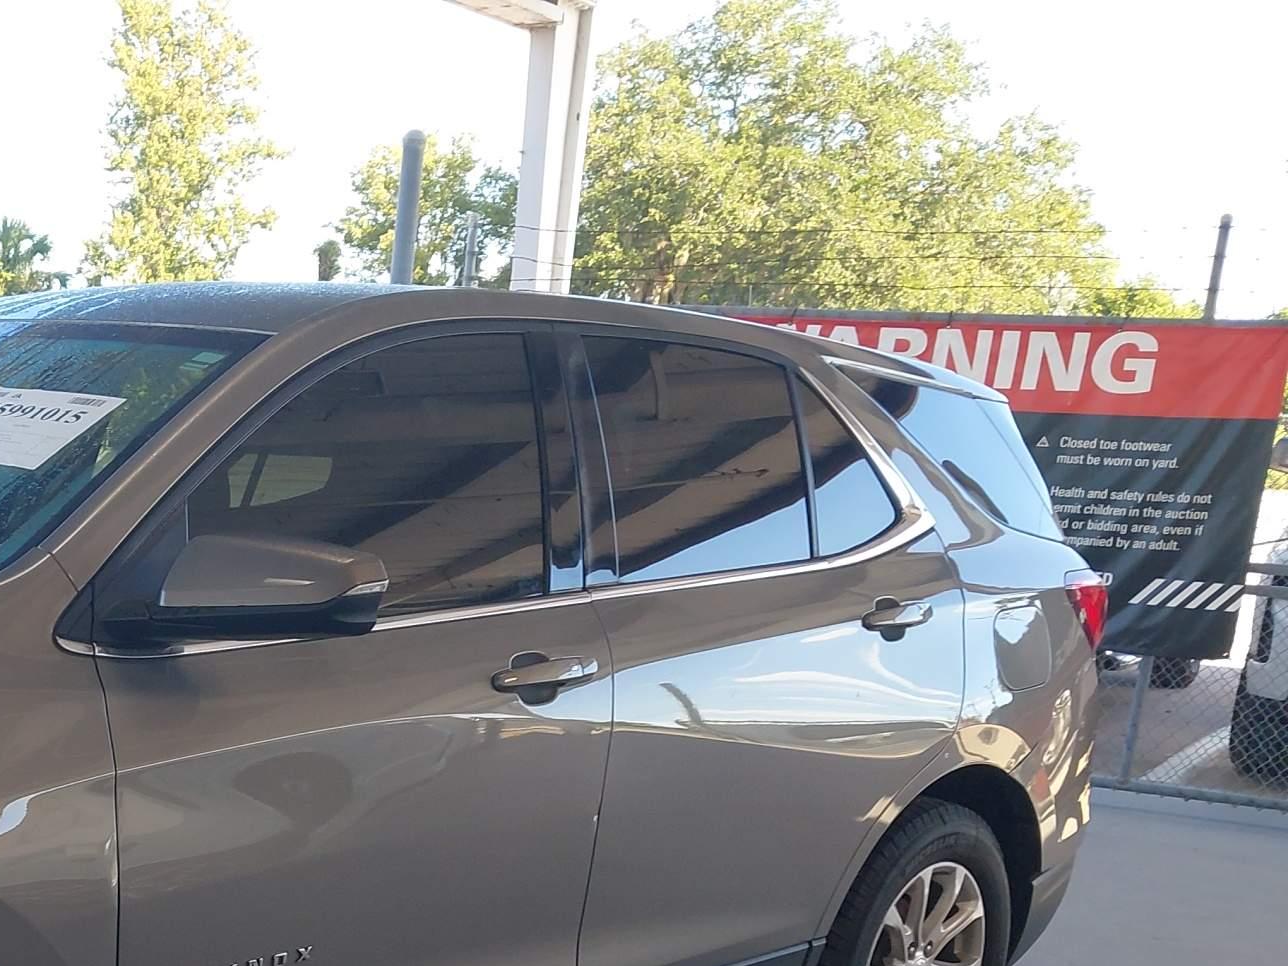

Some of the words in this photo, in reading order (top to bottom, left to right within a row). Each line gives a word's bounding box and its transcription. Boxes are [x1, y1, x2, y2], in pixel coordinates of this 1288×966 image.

[776, 323, 1159, 395] RNING
[1060, 436, 1097, 449] Closed
[1099, 439, 1117, 449] toe
[1120, 439, 1172, 452] footwear
[1056, 454, 1084, 464] must
[1087, 454, 1100, 465] be
[1103, 457, 1132, 466] worn
[1135, 458, 1149, 467] on
[1152, 457, 1179, 470] yard.
[1050, 486, 1084, 498] Health
[1087, 487, 1108, 499] and
[1110, 488, 1144, 502] safety
[1146, 491, 1174, 502] rules
[1177, 493, 1190, 503] do
[1193, 494, 1212, 504] not
[1054, 504, 1081, 513] ermit
[1084, 505, 1127, 516] children
[1128, 507, 1139, 516] in
[1143, 507, 1161, 517] the
[1165, 509, 1208, 520] auction
[1072, 521, 1083, 529] or
[1087, 519, 1128, 534] bidding
[1131, 525, 1159, 535] area,
[1163, 527, 1191, 536] even
[1195, 525, 1204, 536] if
[1116, 537, 1131, 550] by
[1133, 540, 1145, 549] an
[1149, 540, 1180, 551] adult.
